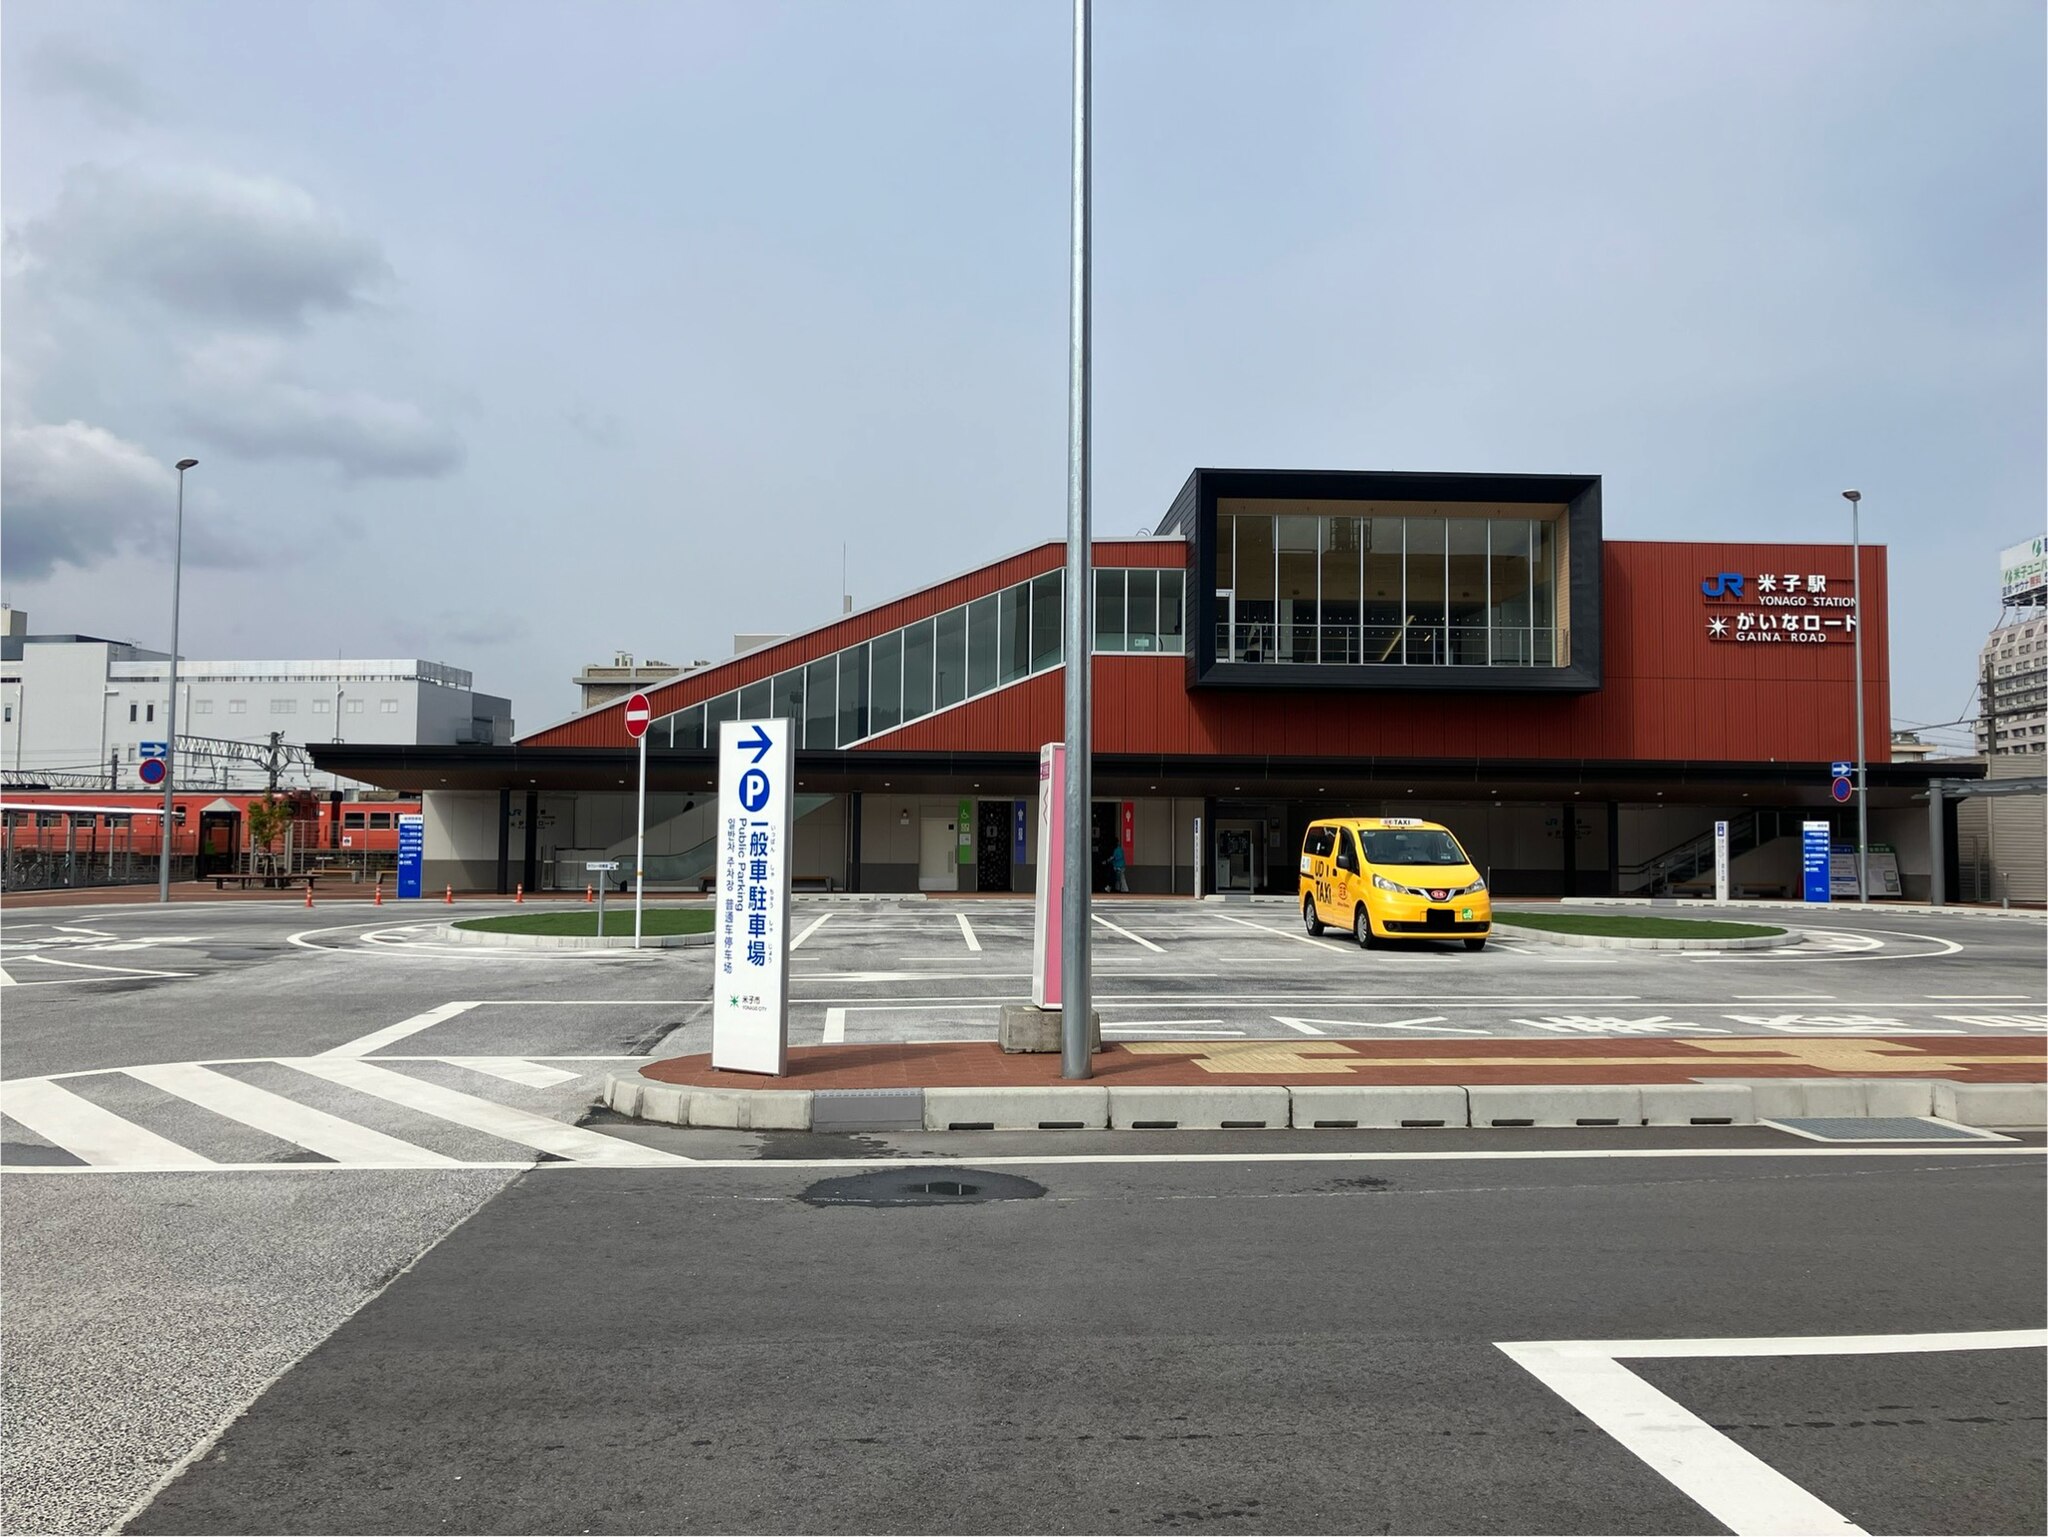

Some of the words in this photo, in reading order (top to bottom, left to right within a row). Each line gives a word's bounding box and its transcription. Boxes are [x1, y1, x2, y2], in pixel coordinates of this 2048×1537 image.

[1702, 572, 1744, 597] JR
[1758, 574, 1826, 593] 米子駅
[1759, 596, 1807, 607] YONAGO
[1736, 632, 1781, 642] GAINA
[1791, 632, 1827, 643] ROAD
[746, 775, 765, 807] P
[738, 818, 747, 858] Public
[726, 856, 735, 892] 주차장
[735, 862, 746, 912] Parking
[747, 822, 769, 967] 一般車駐車場
[1316, 880, 1332, 904] TAXI
